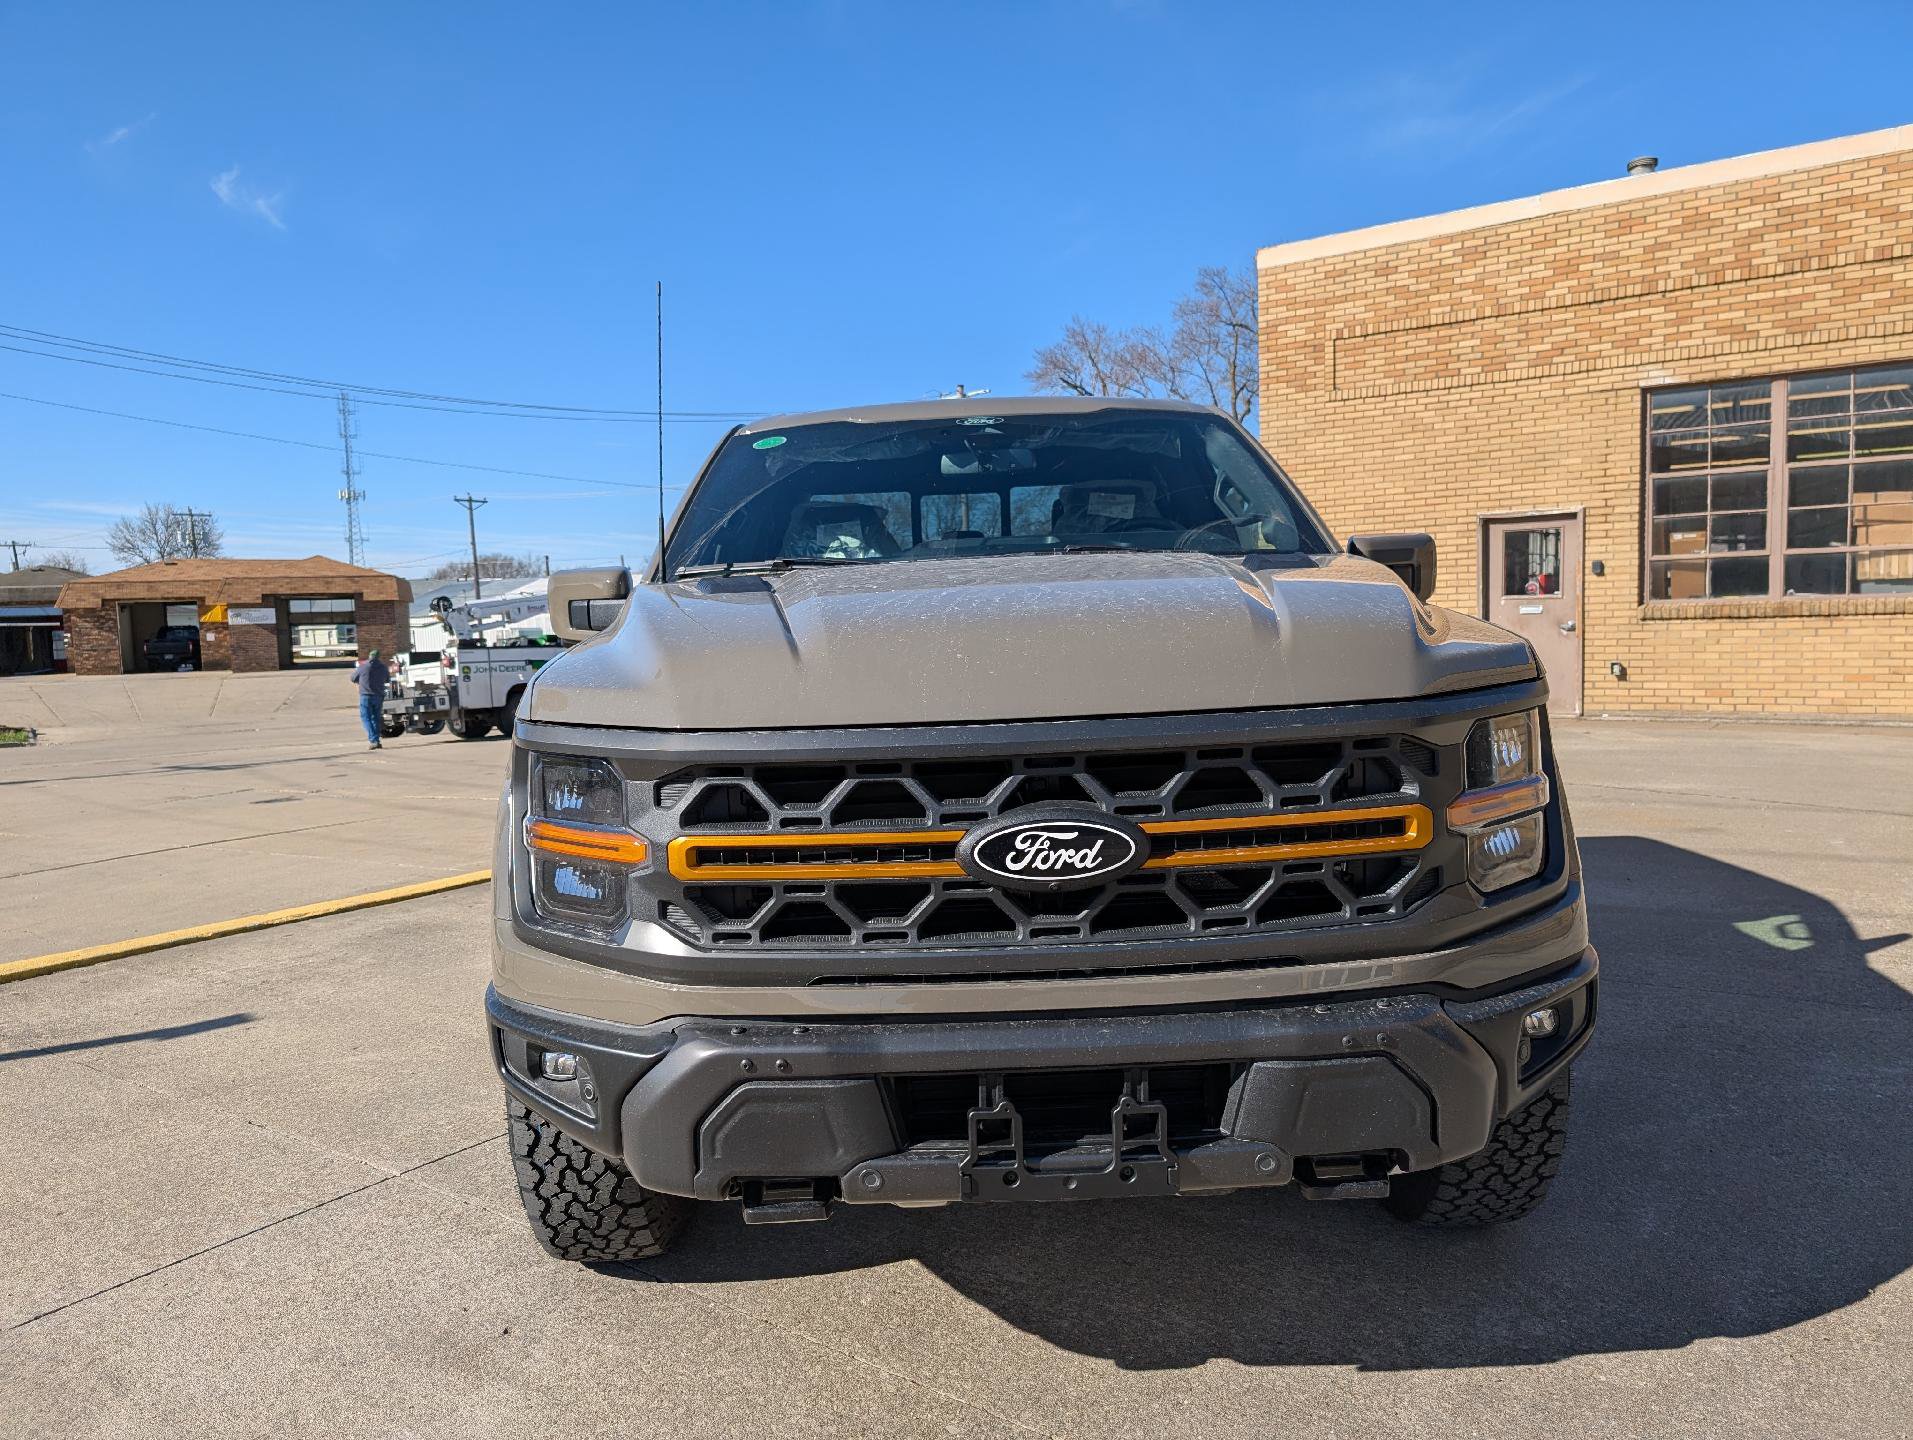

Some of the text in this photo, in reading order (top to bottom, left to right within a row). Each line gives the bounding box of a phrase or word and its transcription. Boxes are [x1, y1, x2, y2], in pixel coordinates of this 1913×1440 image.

[473, 664, 527, 674] JOHN DEERE
[1005, 831, 1105, 871] Ford
